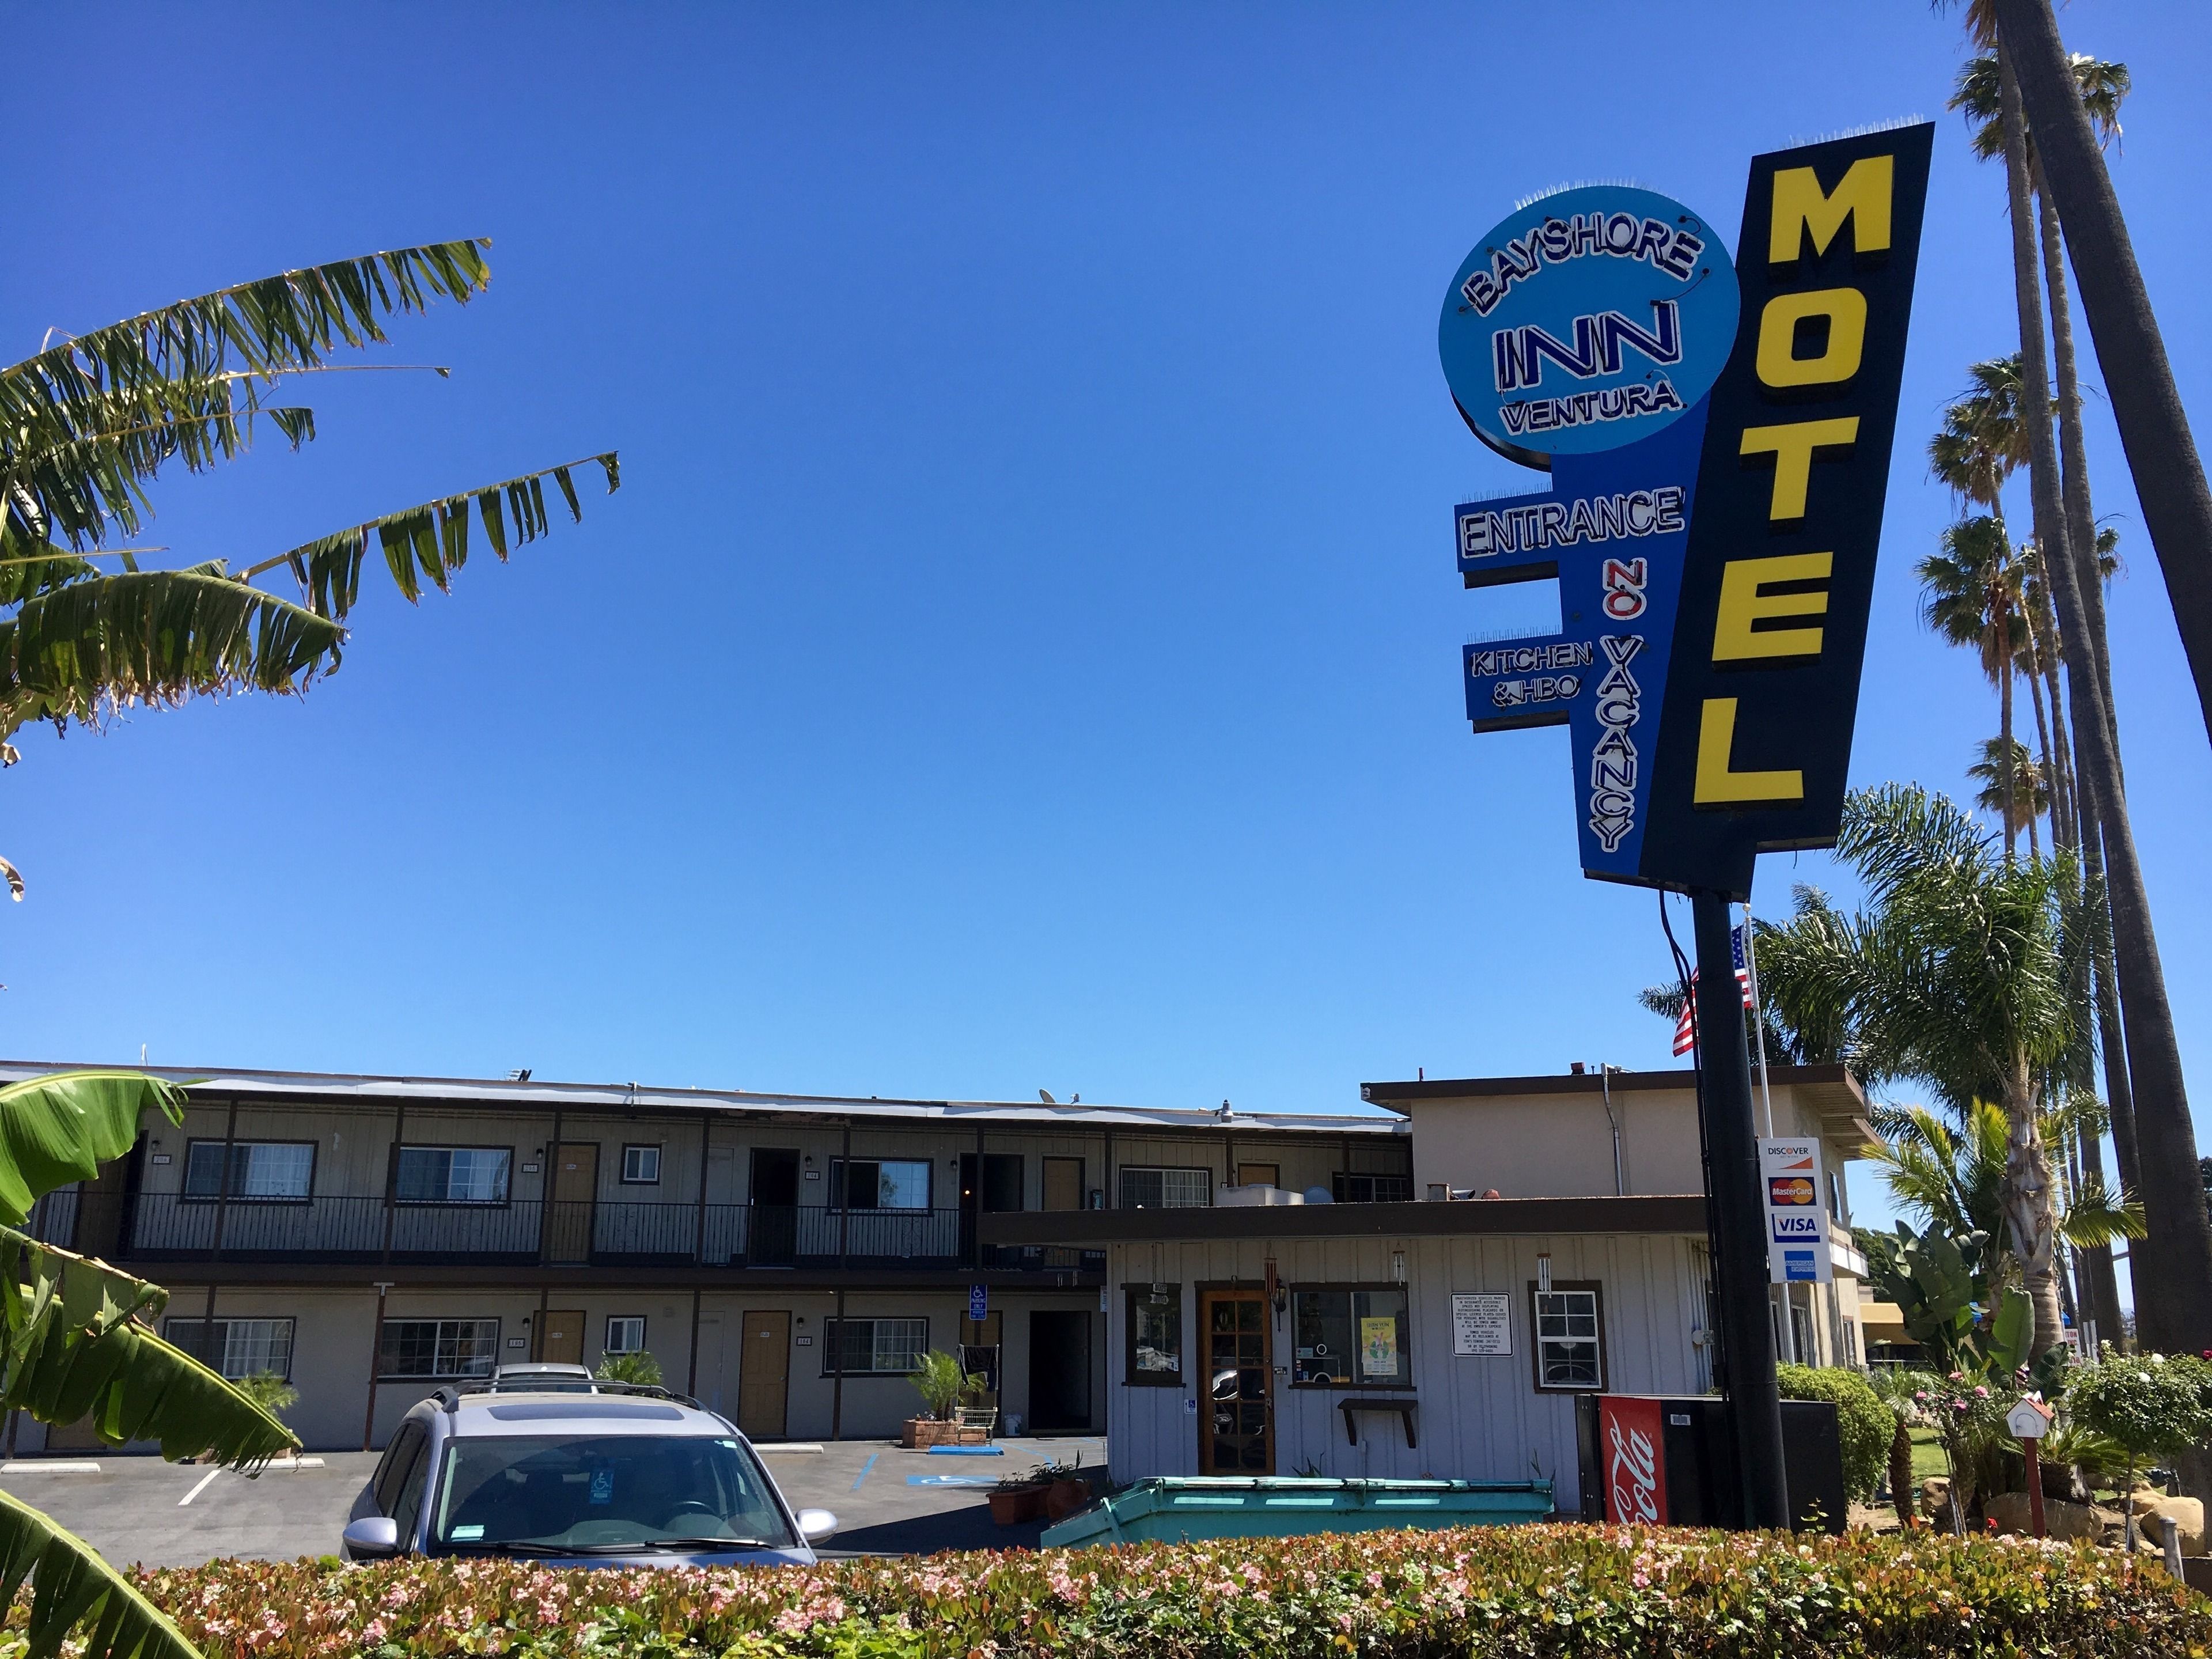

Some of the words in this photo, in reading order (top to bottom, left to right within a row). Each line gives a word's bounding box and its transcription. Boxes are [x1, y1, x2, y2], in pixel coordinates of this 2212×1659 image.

[1461, 211, 1705, 317] BAYSHORE
[1492, 299, 1683, 392] INN
[1499, 380, 1684, 436] VENTURA
[1693, 154, 1895, 808] MOTEL
[1460, 486, 1684, 559] ENTRANCE
[1603, 558, 1647, 620] NO
[1471, 641, 1593, 677] KITCHEN
[1588, 635, 1645, 853] VACANCY
[1768, 1147, 1809, 1155] DISCOVER
[1778, 1218, 1816, 1232] VISA
